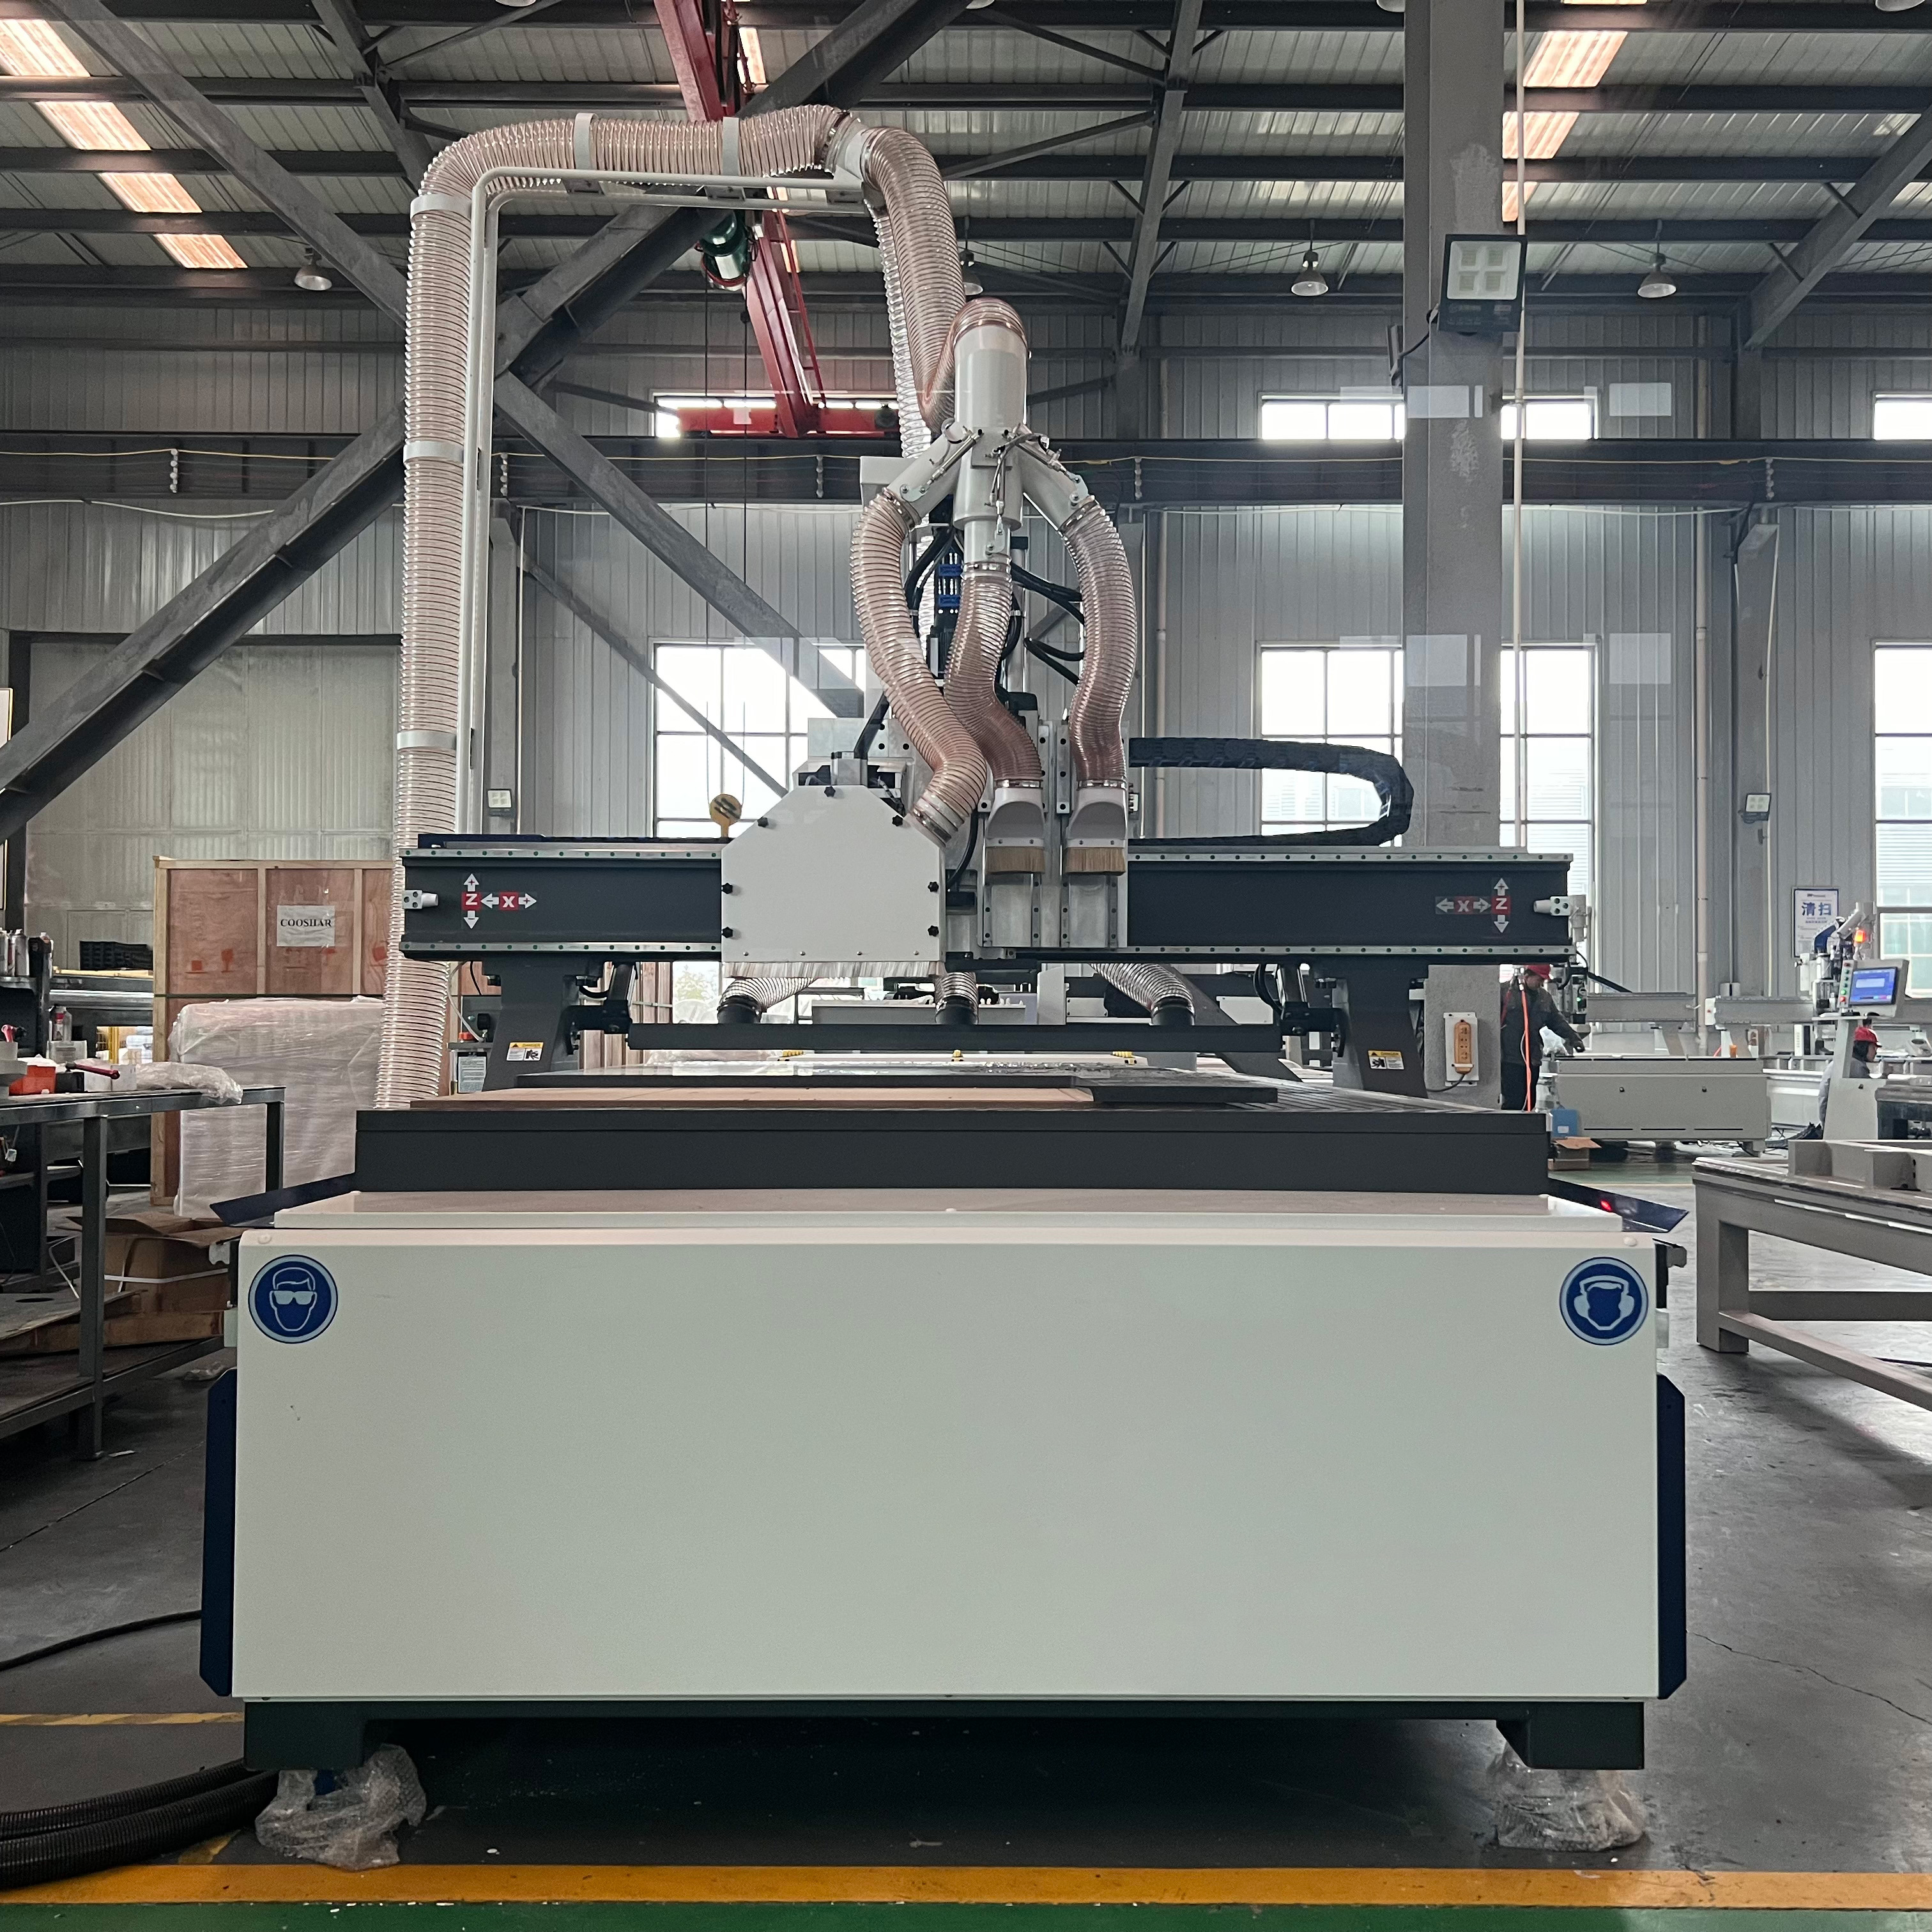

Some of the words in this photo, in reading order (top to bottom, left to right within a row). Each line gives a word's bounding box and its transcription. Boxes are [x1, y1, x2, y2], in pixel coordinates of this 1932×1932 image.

[465, 893, 478, 905] Z
[502, 896, 516, 908] X
[1457, 900, 1470, 912] X
[1496, 898, 1508, 910] Z
[1801, 901, 1832, 916] 清扫
